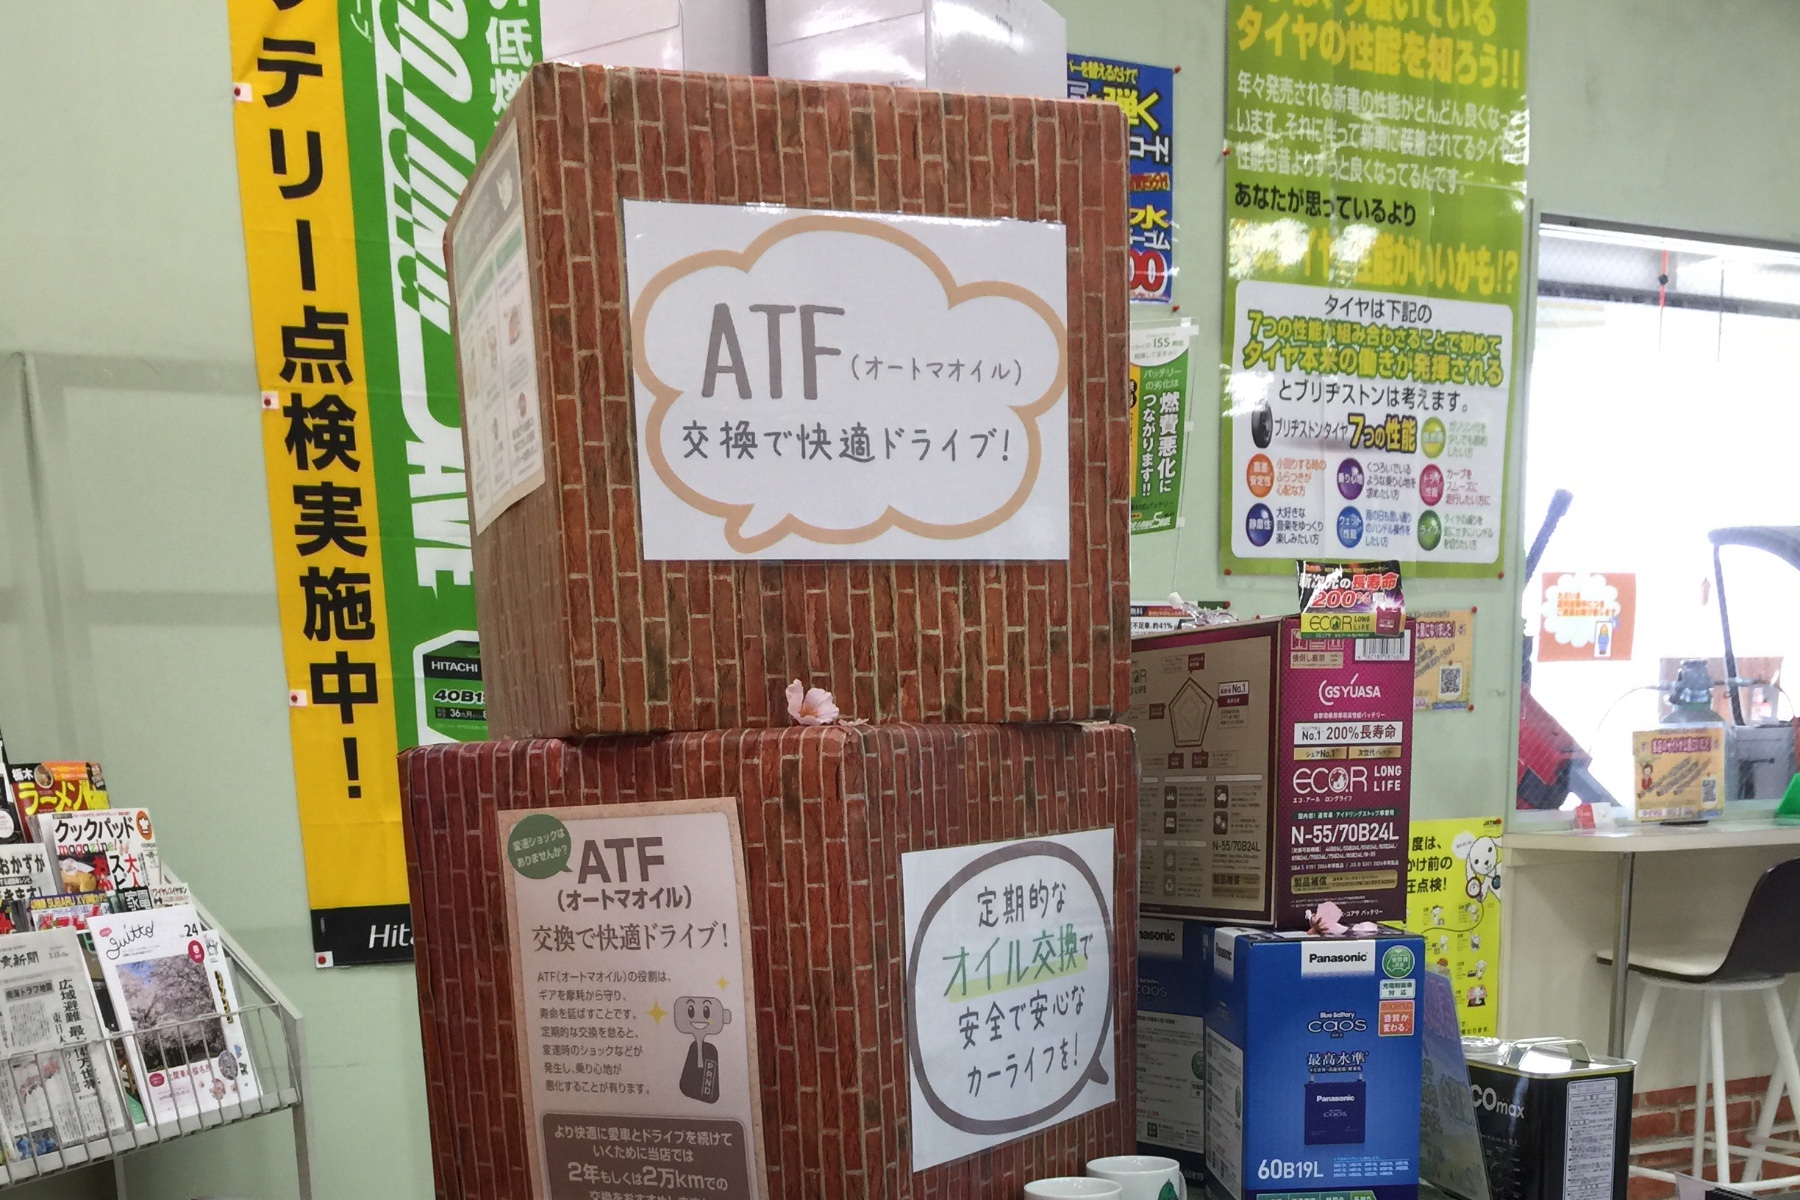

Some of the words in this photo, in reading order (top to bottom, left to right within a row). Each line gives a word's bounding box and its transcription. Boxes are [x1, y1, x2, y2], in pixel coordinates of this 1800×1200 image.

[1236, 4, 1521, 90] タイヤの性能を知ろう!!
[1234, 181, 1418, 227] あなたが思っているより
[1325, 294, 1433, 324] タイヤは下記の
[701, 302, 846, 401] ATF
[850, 353, 1024, 387] (オートマオイル)
[1144, 368, 1183, 379] バッテリー
[257, 0, 379, 799] テリー点検実施中!
[1278, 378, 1469, 414] とブリヂストンは考えます。
[681, 419, 1010, 462] 交換で快適ドライブ!
[1157, 391, 1180, 494] 燃費悪化に
[430, 660, 479, 673] HITACHI
[432, 688, 486, 705] 40B1
[1373, 765, 1402, 778] LONG
[1373, 780, 1402, 793] LIFE
[54, 815, 135, 844] クックパッド
[512, 828, 567, 852] 変速ショックは
[1291, 822, 1400, 846] N-55/70B24L
[516, 844, 569, 868] ありませんか?
[577, 836, 665, 884] ATF
[556, 884, 693, 912] (オートマオイル)
[977, 879, 1067, 928] 定期的な
[184, 923, 199, 938] 24
[531, 921, 730, 954] 交換で快適ドライブ!
[942, 923, 1094, 998] オイル交換で
[1309, 951, 1367, 964] Panasonic
[537, 970, 672, 984] ATF(オートマオイル)の役割は、
[538, 989, 627, 1002] ギアを摩耗から守り、
[539, 1007, 637, 1021] 寿命を延ばすことです。
[958, 985, 1086, 1050] 安全で安心な
[1384, 1013, 1410, 1023] 音質が
[541, 1025, 639, 1039] 定期的な交換を怠ると、
[1308, 1020, 1367, 1033] caos
[542, 1043, 643, 1058] 変速時のショックなどが
[1308, 1051, 1366, 1067] 最高水準
[544, 1061, 623, 1076] 発生し、乗り心地が
[967, 1033, 1079, 1098] カーライフを!
[545, 1079, 651, 1096] 悪化することが有ります。
[1316, 1094, 1355, 1103] Panasonic
[554, 1124, 733, 1147] より快適に愛車とドライブを続けて
[592, 1144, 695, 1163] いくために当店では
[567, 1160, 729, 1192] 2年もしくは2万kmでの
[1257, 1158, 1324, 1180] 60B19L
